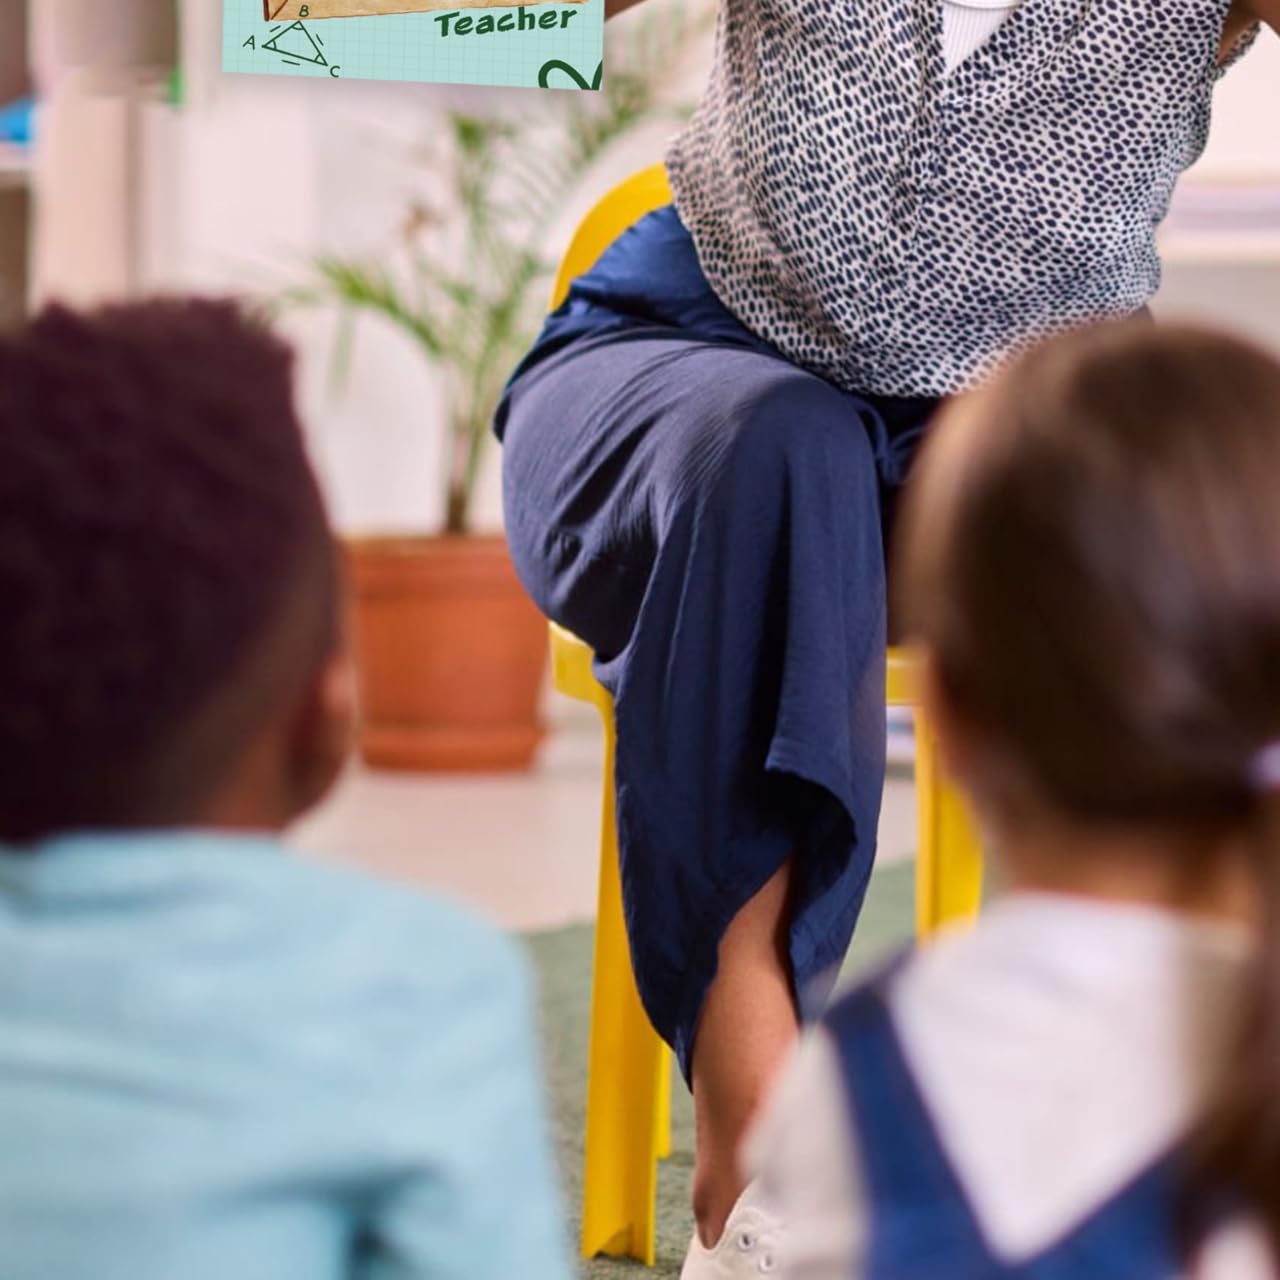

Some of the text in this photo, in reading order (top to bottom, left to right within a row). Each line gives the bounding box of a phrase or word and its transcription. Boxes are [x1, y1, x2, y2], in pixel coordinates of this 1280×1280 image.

[299, 5, 309, 17] B
[434, 7, 577, 37] Teacher
[242, 35, 255, 50] A
[330, 66, 341, 78] C
